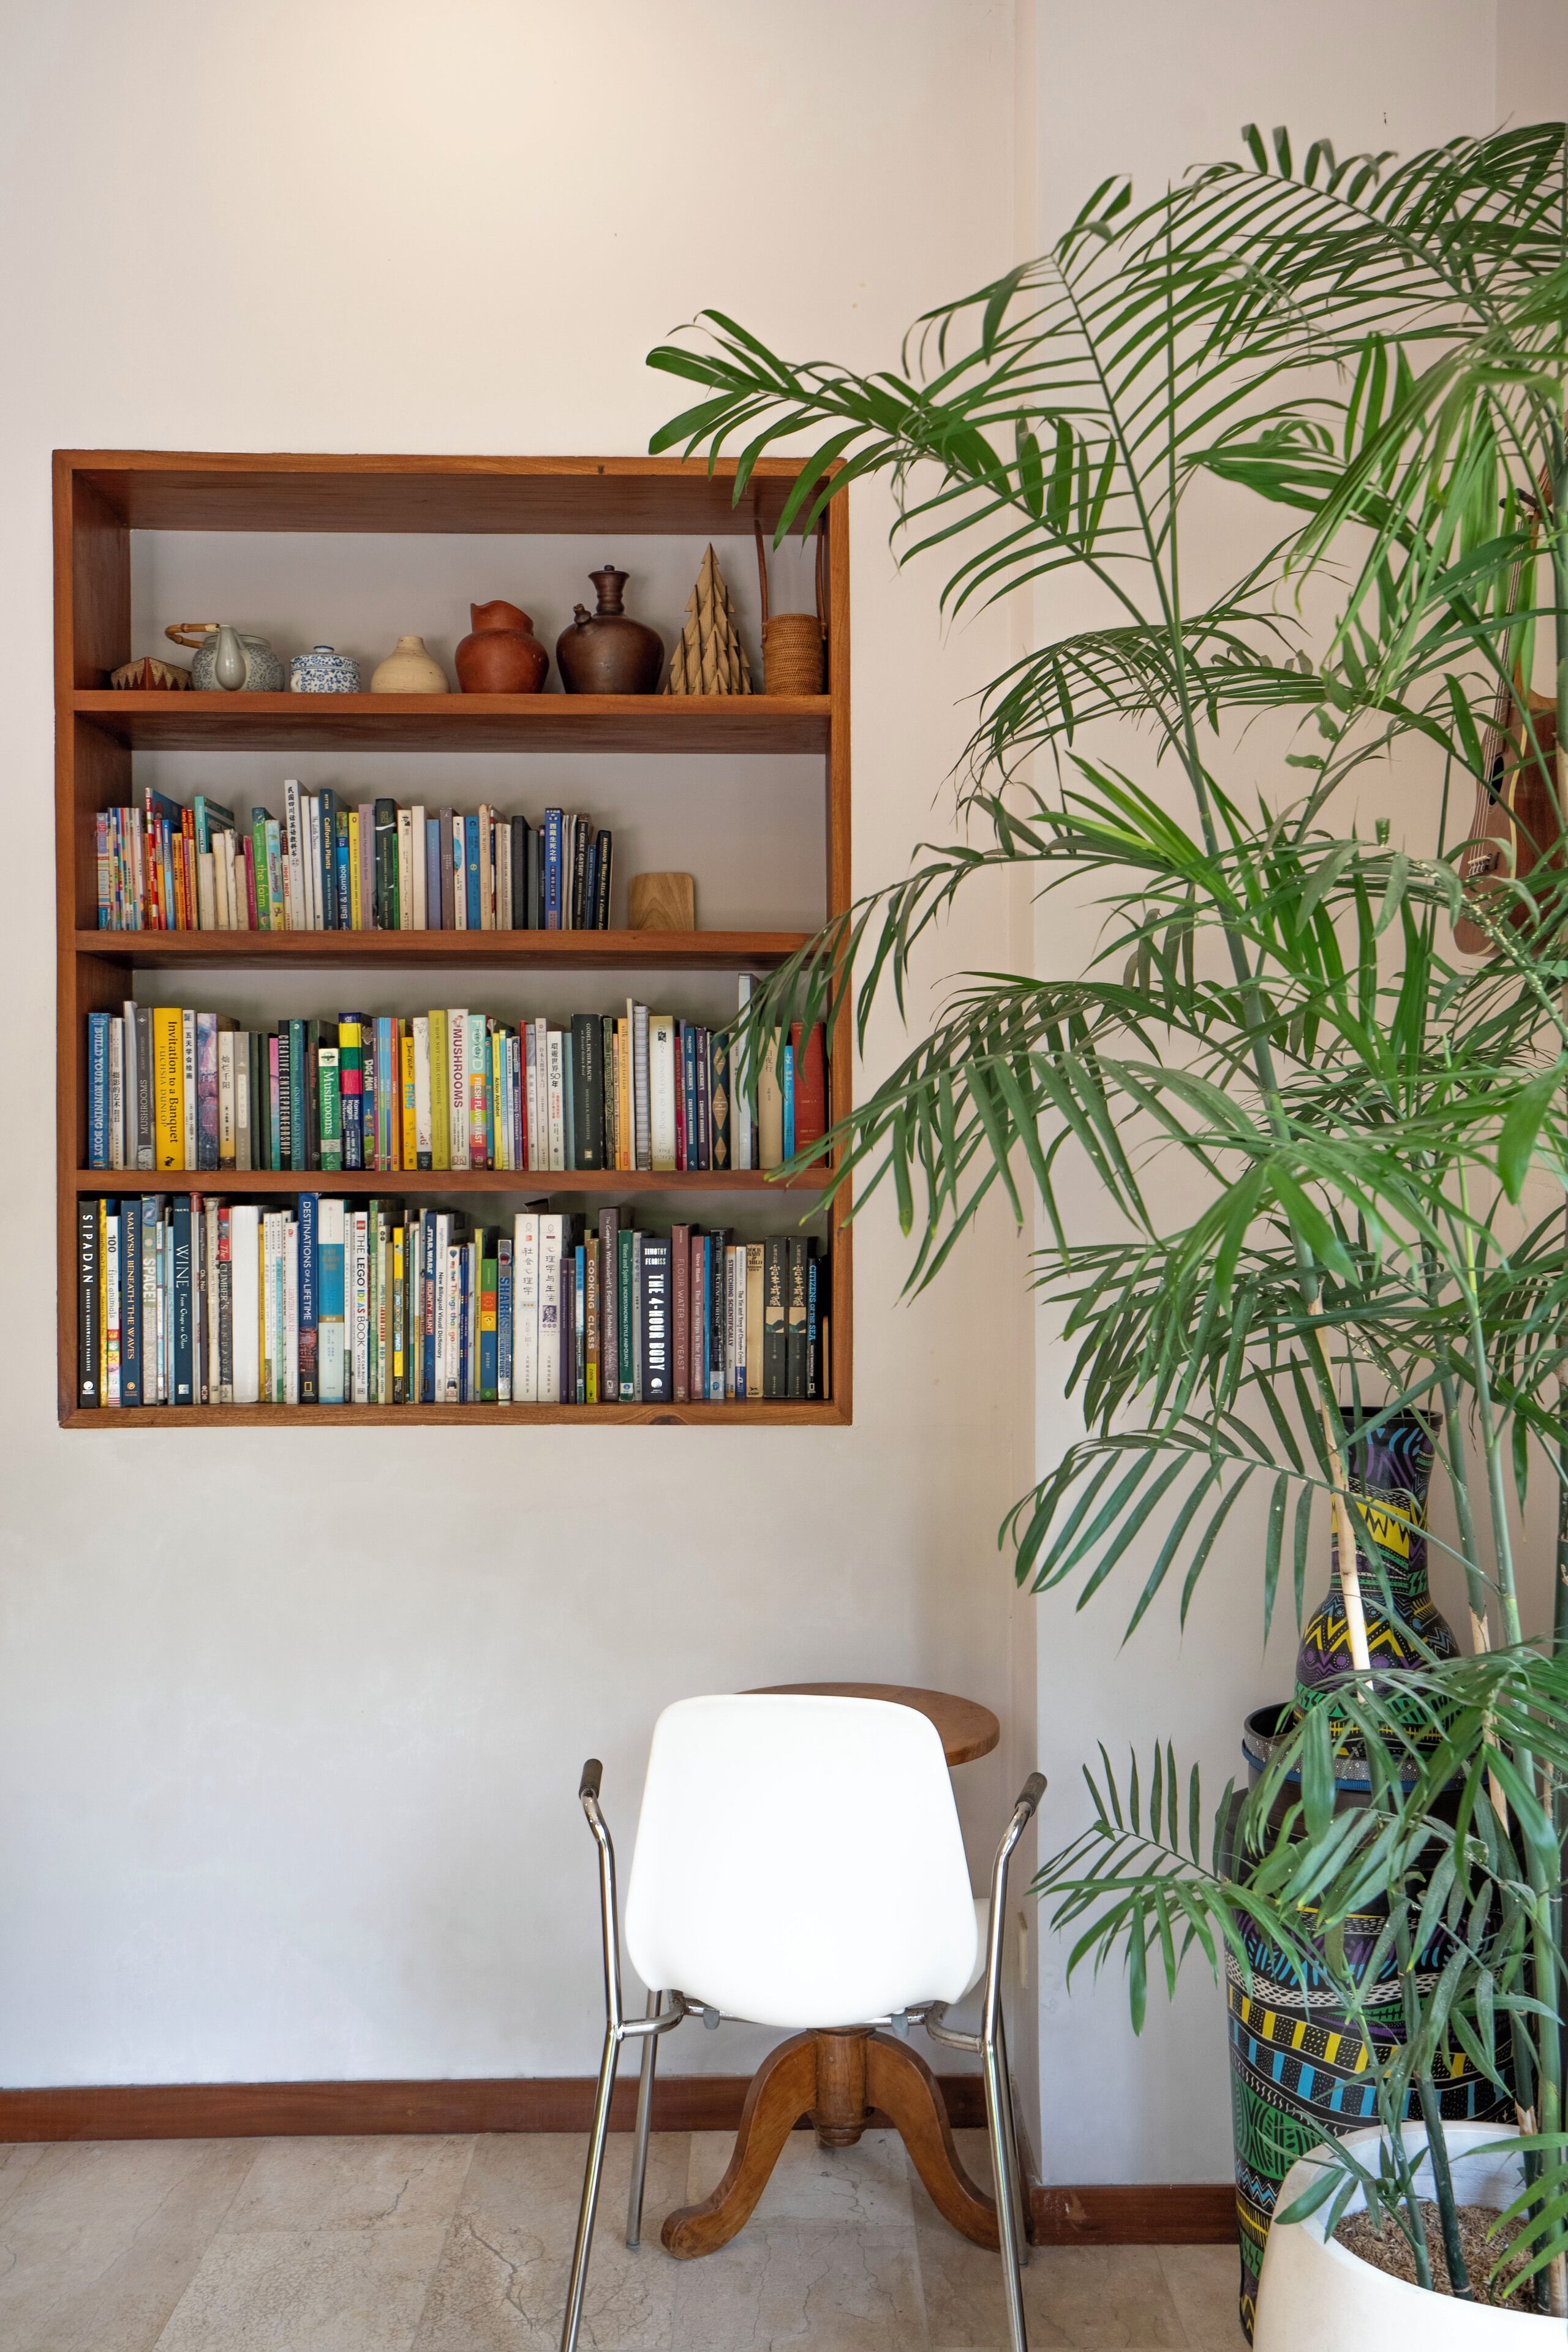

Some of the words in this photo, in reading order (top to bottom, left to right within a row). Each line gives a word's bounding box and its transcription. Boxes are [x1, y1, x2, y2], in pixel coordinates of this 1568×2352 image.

[258, 865, 266, 880] the
[258, 884, 268, 907] farm
[339, 904, 348, 918] Bali
[94, 1027, 102, 1056] BUILD
[168, 1022, 178, 1074] Invitation
[279, 1035, 289, 1072] CREATIVE
[169, 1078, 176, 1087] to
[364, 1059, 374, 1075] DOG
[364, 1076, 374, 1091] MAN
[453, 1029, 463, 1108] MUSHROOMS
[94, 1087, 103, 1129] RUNNING
[279, 1077, 290, 1155] ENTREPRENEURSHIP
[323, 1071, 334, 1134] Mushrooms
[168, 1098, 179, 1143] Banquet
[94, 1130, 103, 1157] BODY
[83, 1215, 93, 1283] SIPADAN
[108, 1234, 116, 1253] 100
[303, 1201, 311, 1267] DESTINATIONS
[176, 1245, 189, 1289] WINE
[220, 1244, 228, 1258] The
[143, 1258, 156, 1302] SPACE!
[357, 1257, 366, 1287] LEGO
[522, 1248, 534, 1295] 社会心理学
[546, 1247, 556, 1302] 心理学与生活
[649, 1274, 664, 1294] THE
[108, 1288, 117, 1318] animals
[357, 1289, 366, 1313] IDEAS
[499, 1277, 510, 1329] SHARKS
[648, 1297, 664, 1338] 4-HOUR
[649, 1343, 665, 1370] BODY
